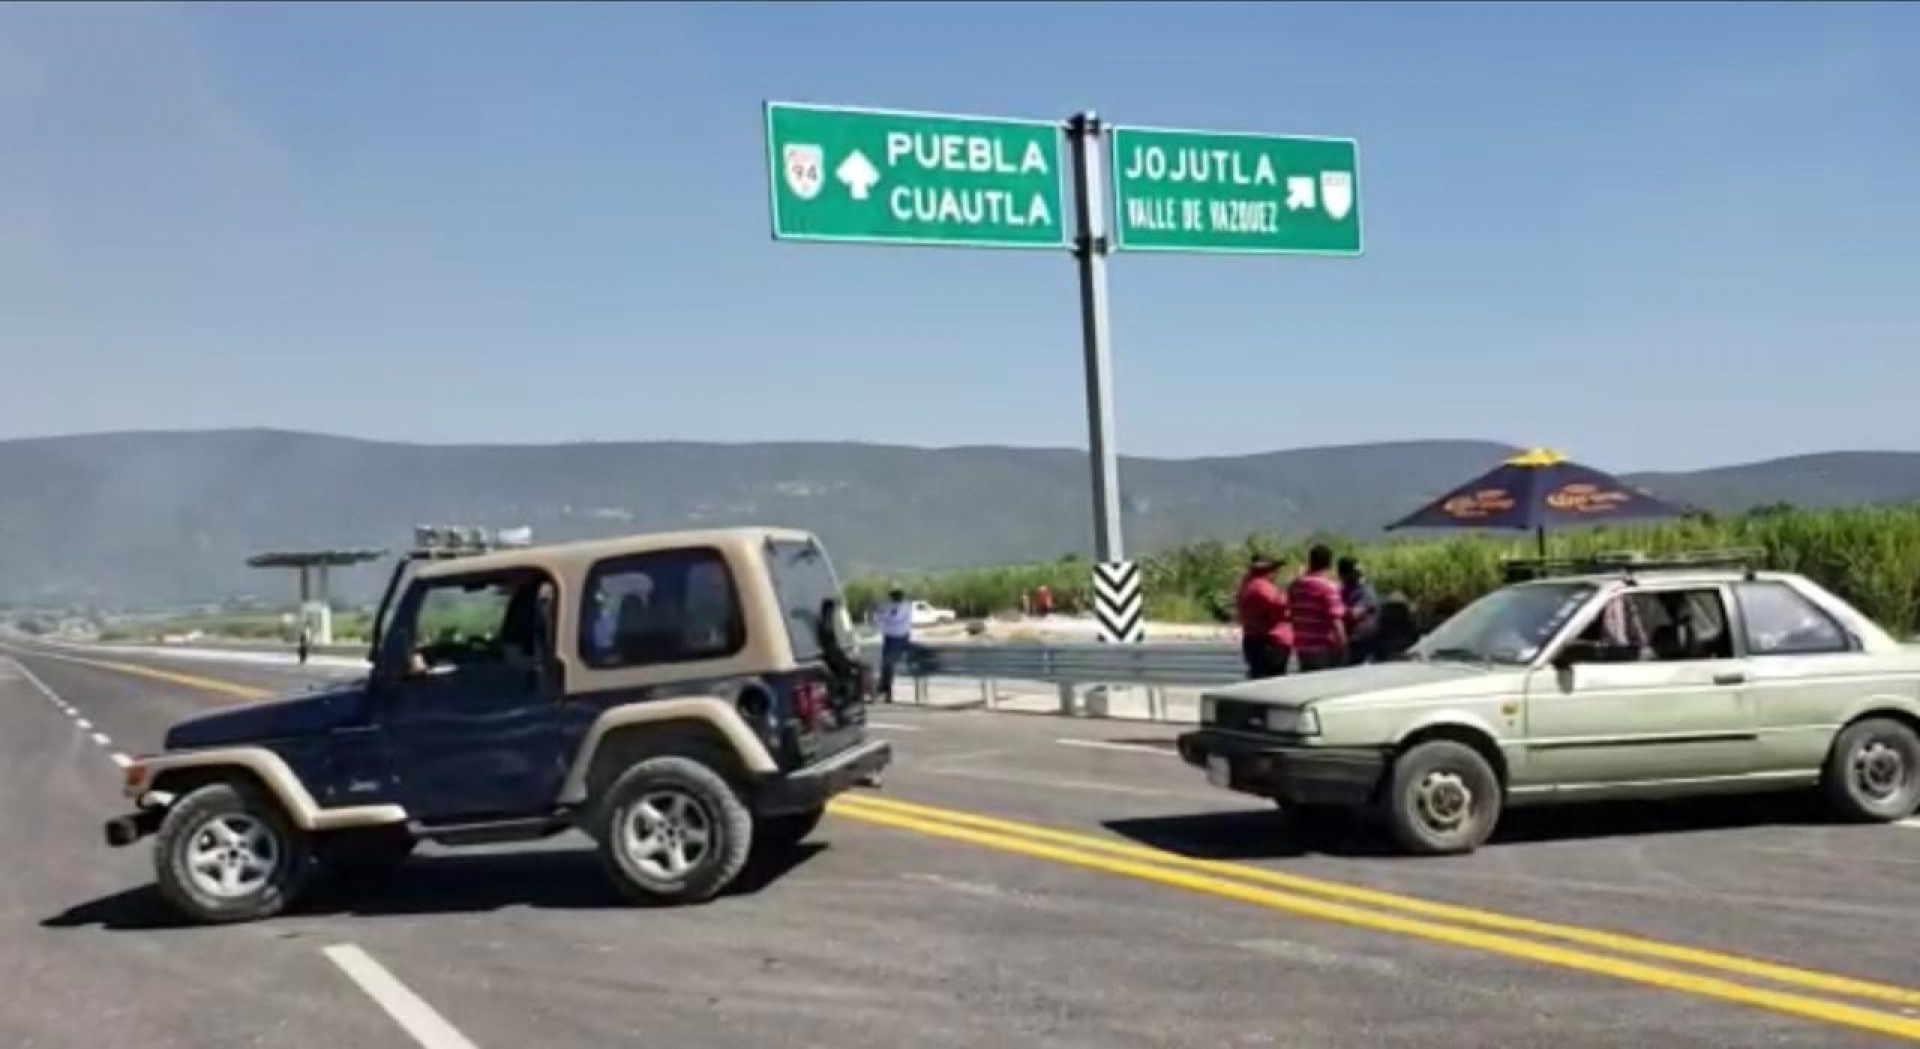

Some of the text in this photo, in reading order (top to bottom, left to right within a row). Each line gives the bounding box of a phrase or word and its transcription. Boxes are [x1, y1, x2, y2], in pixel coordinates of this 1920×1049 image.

[887, 132, 1048, 175] PUEBLA
[1125, 146, 1277, 186] JOJUTLA
[890, 186, 1052, 226] CUAUTLA
[1127, 197, 1177, 229] VALLE
[1182, 198, 1204, 231] DE
